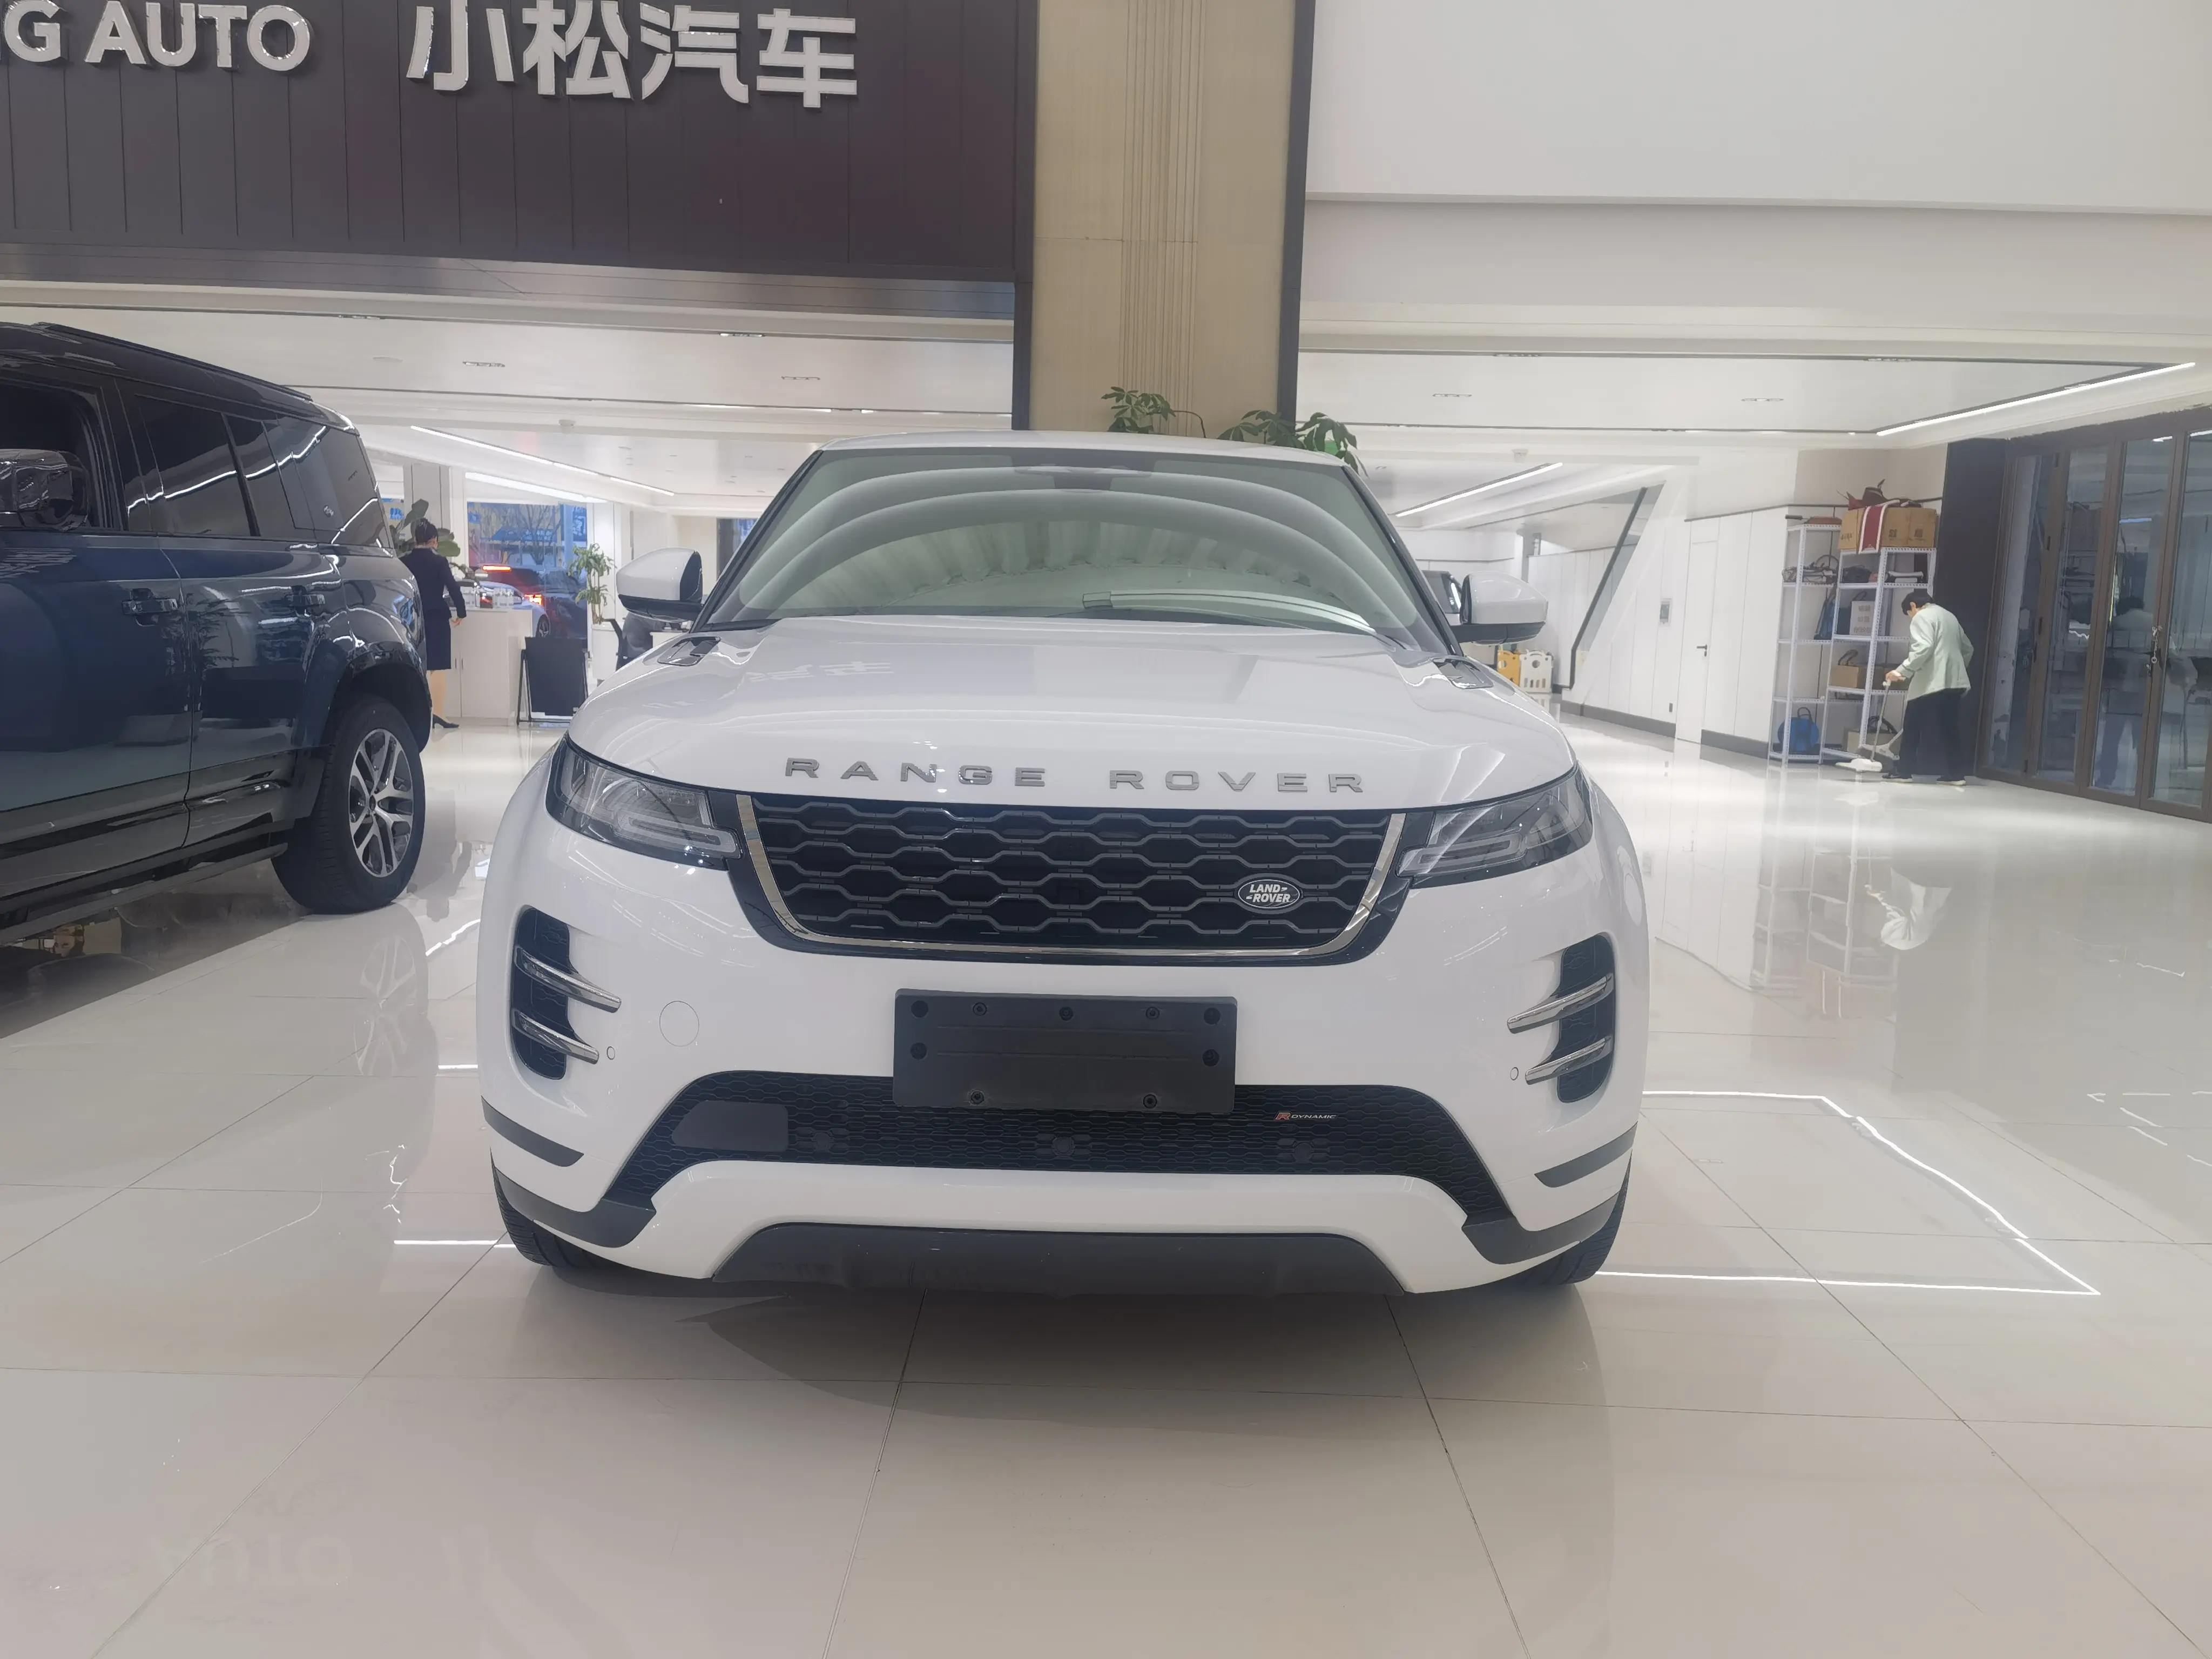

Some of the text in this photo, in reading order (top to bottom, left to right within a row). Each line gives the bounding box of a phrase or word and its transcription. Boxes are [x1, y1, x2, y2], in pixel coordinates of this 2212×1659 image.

[84, 0, 312, 71] AUTO
[406, 0, 858, 108] 小松汽车
[785, 757, 1364, 793] RANGE ROVER
[1249, 884, 1281, 893] LAND
[1252, 893, 1291, 902] ROVER
